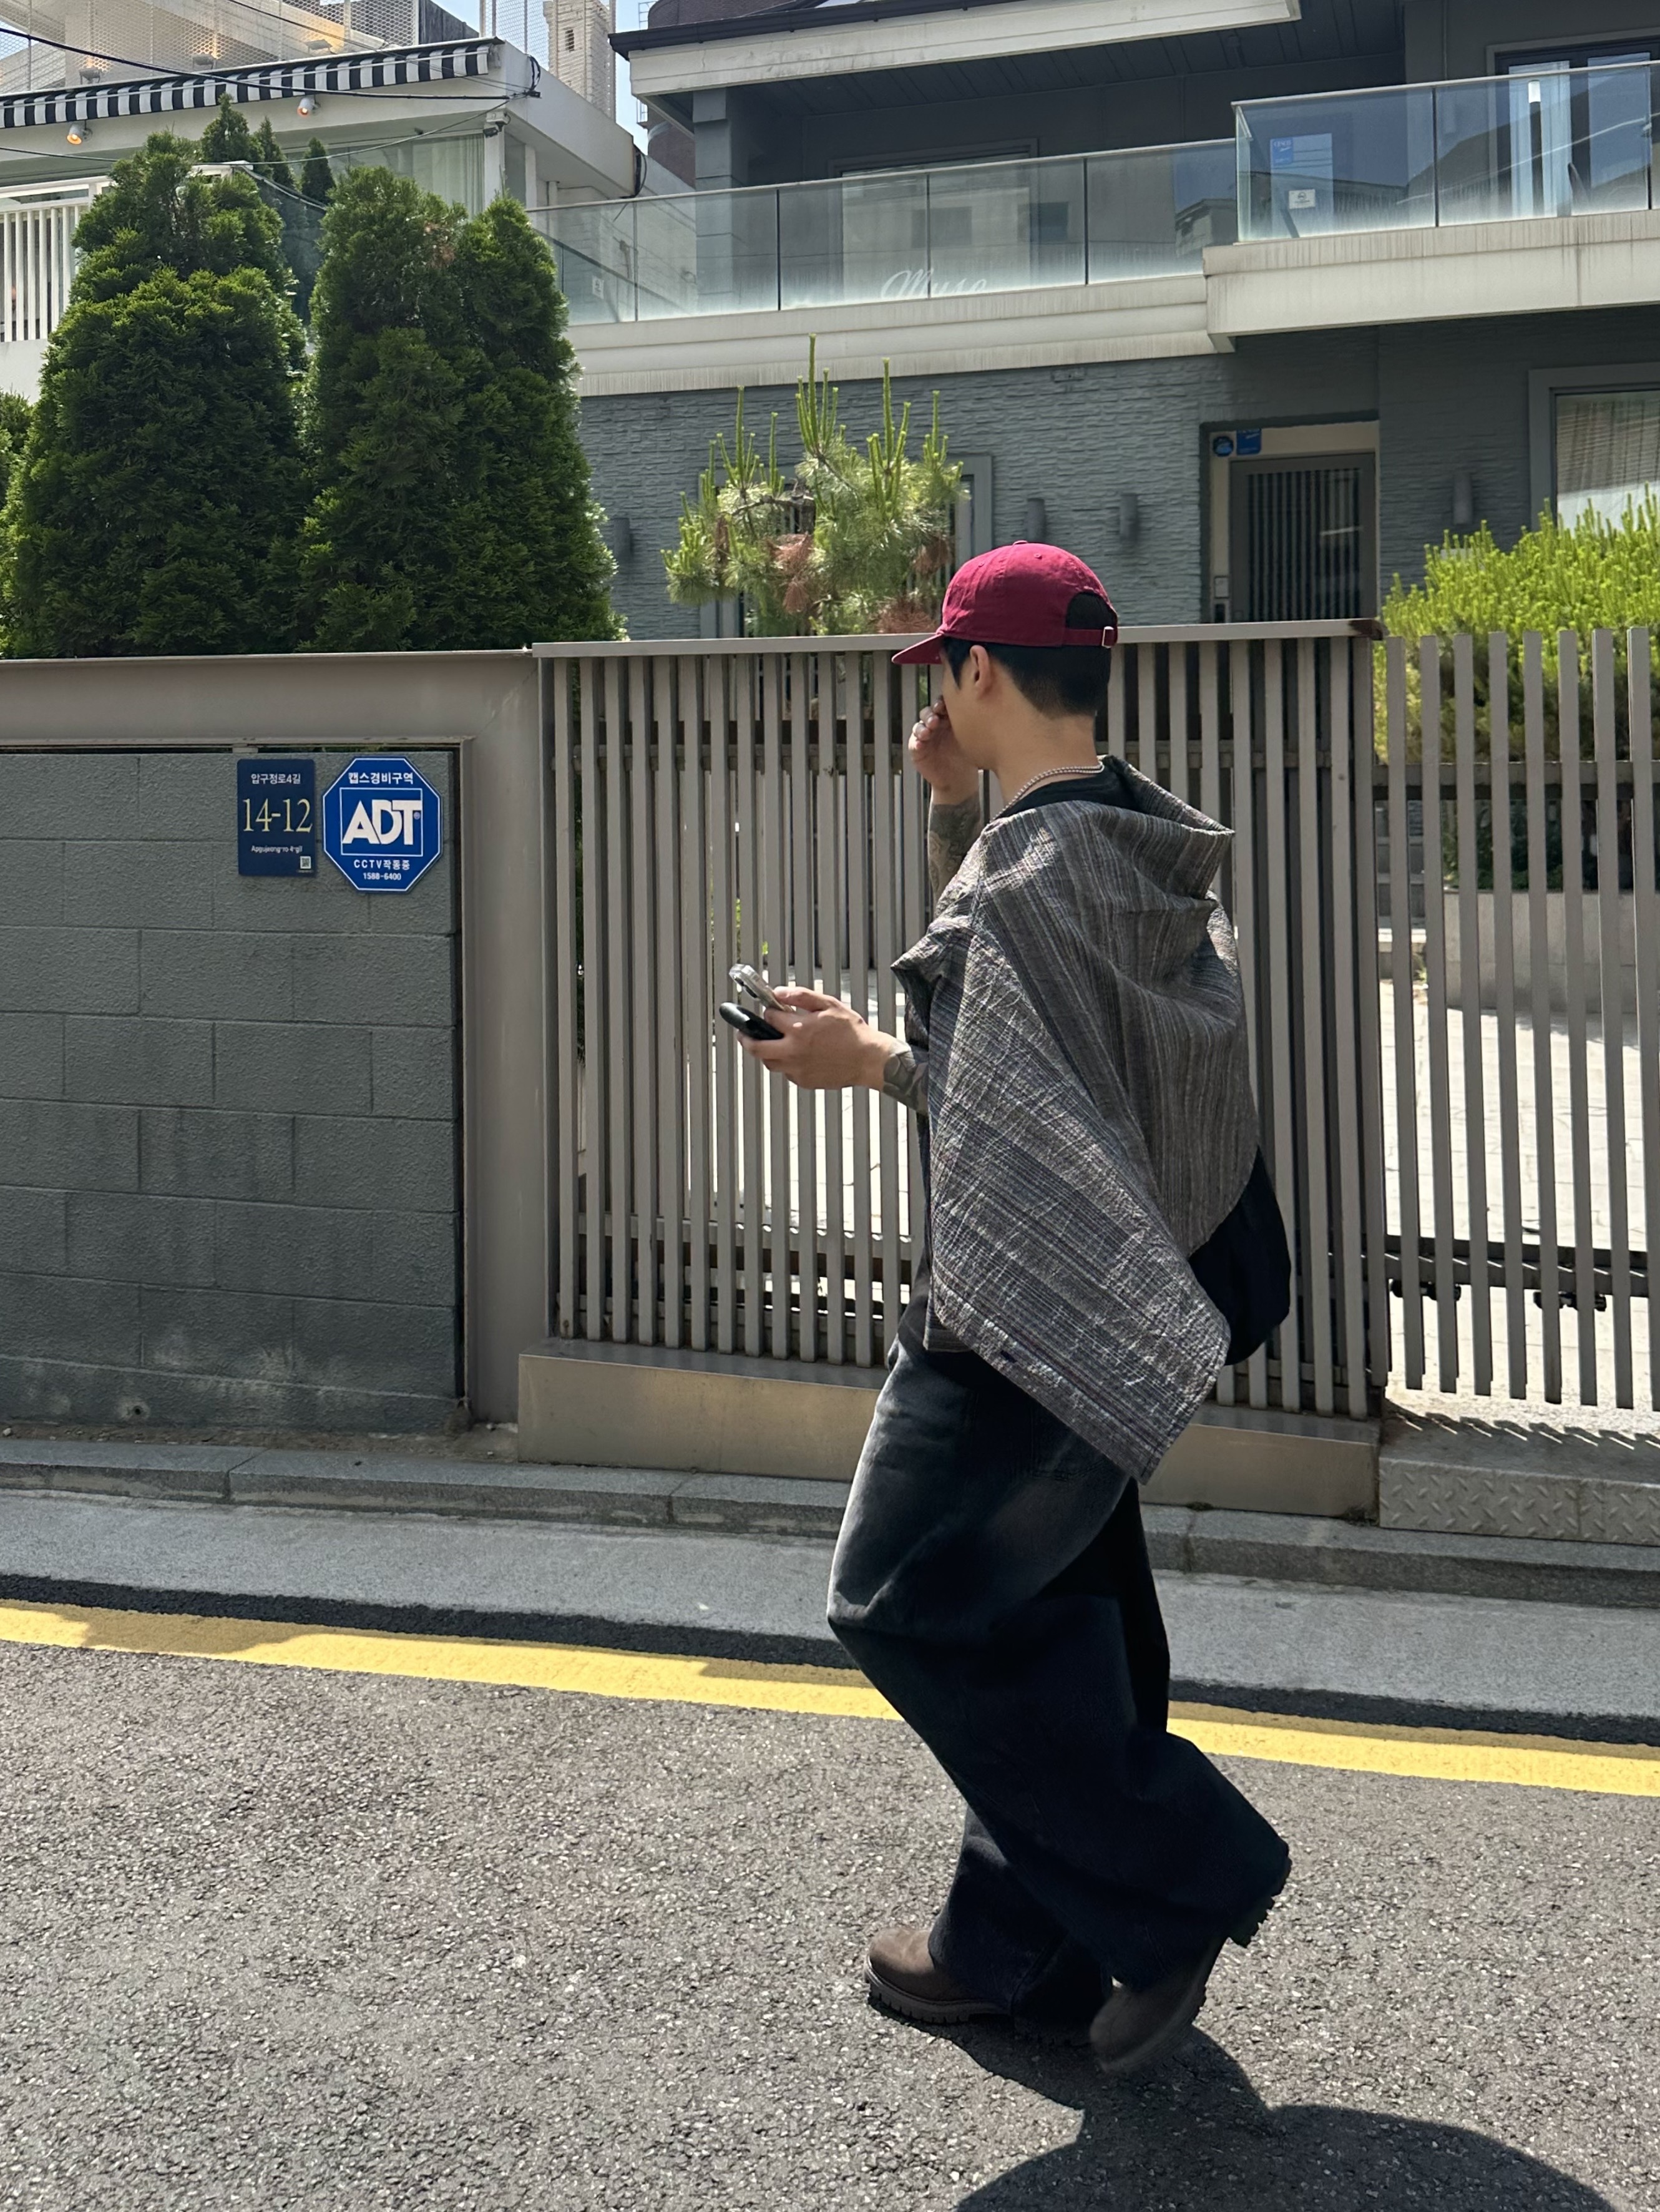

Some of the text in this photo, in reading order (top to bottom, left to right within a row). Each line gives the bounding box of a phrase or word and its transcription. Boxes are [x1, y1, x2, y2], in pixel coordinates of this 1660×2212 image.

[251, 773, 301, 785] 압구정로4길
[348, 771, 414, 785] 캡스경비구역
[243, 798, 313, 834] 14-12
[342, 799, 422, 846] ADT
[353, 859, 410, 871] CCTV작동중
[363, 872, 402, 881] 1588-6400
